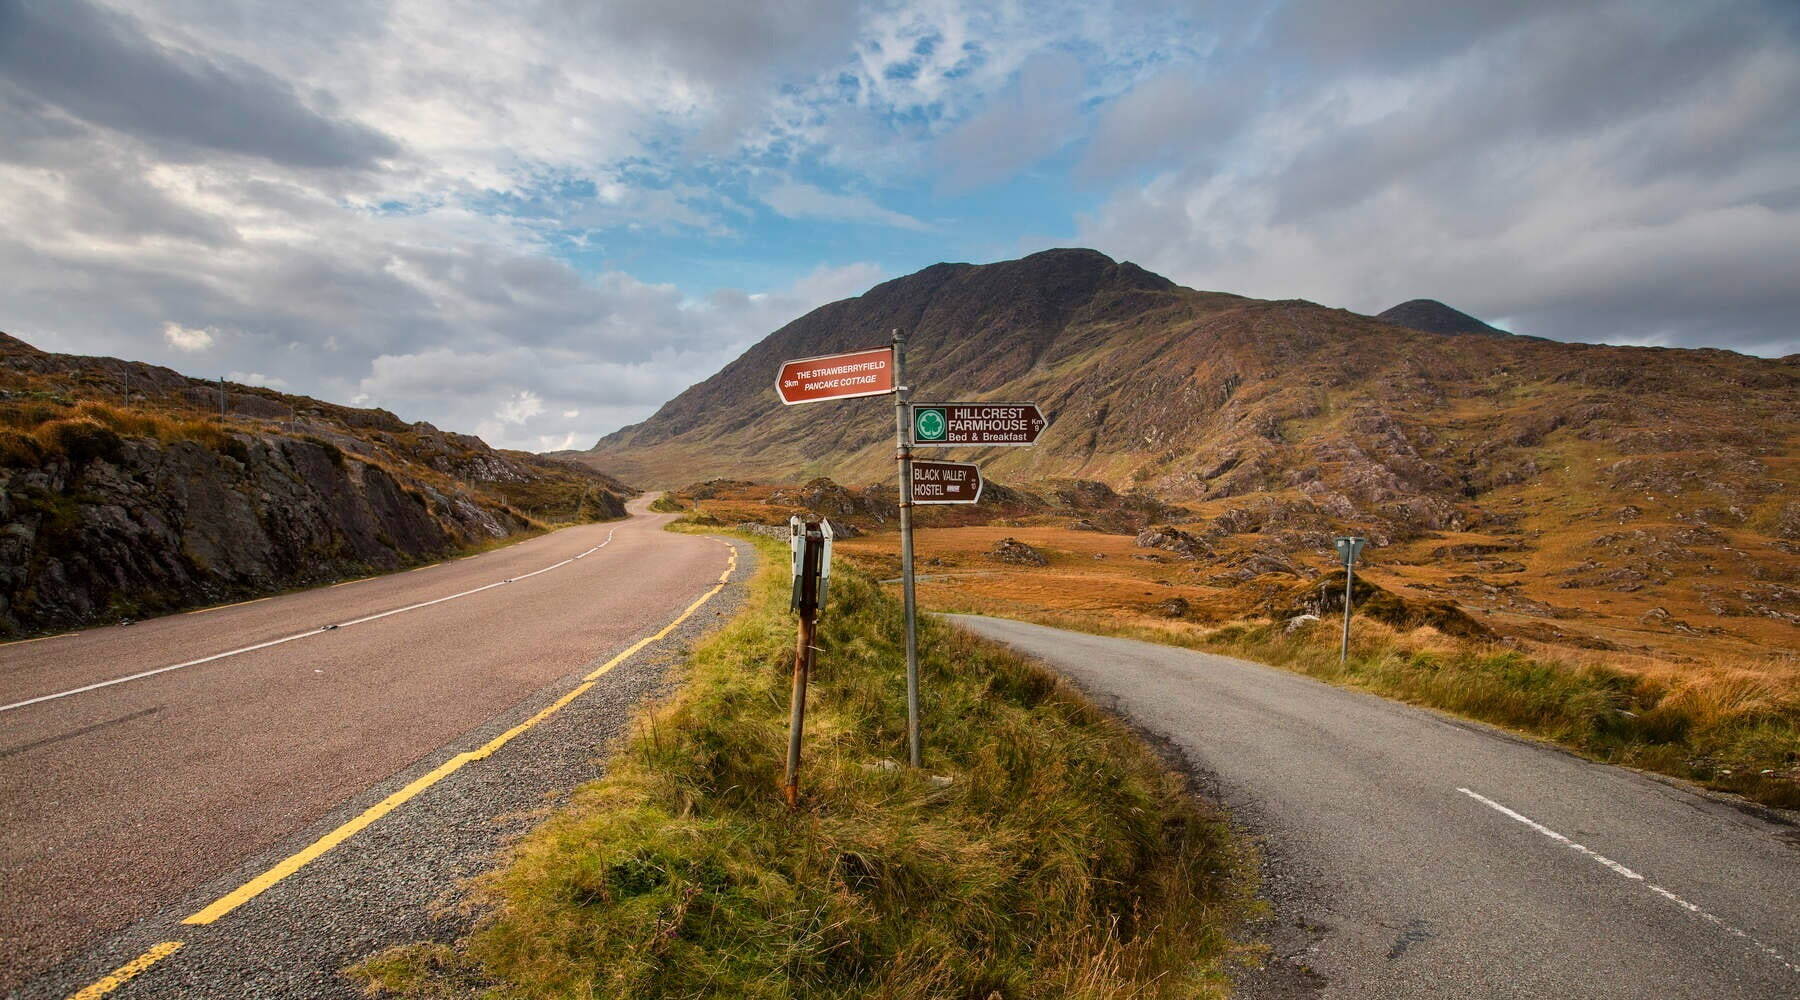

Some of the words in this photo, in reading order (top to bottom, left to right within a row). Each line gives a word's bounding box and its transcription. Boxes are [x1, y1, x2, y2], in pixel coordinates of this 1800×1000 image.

[797, 371, 811, 380] THE
[812, 361, 886, 378] STRAWBERRYFIELD
[784, 380, 799, 388] 3km
[804, 379, 839, 391] PANCAKE
[840, 375, 877, 387] COTTAGE
[954, 408, 1025, 419] HILLCREST
[948, 420, 1028, 431] FARMHOUSE
[948, 433, 967, 441] Bed
[971, 433, 979, 441] &
[983, 432, 1027, 441] Breakfast
[914, 468, 940, 481] BLACK
[942, 470, 967, 481] VALLEY
[914, 484, 944, 496] HOSTEL
